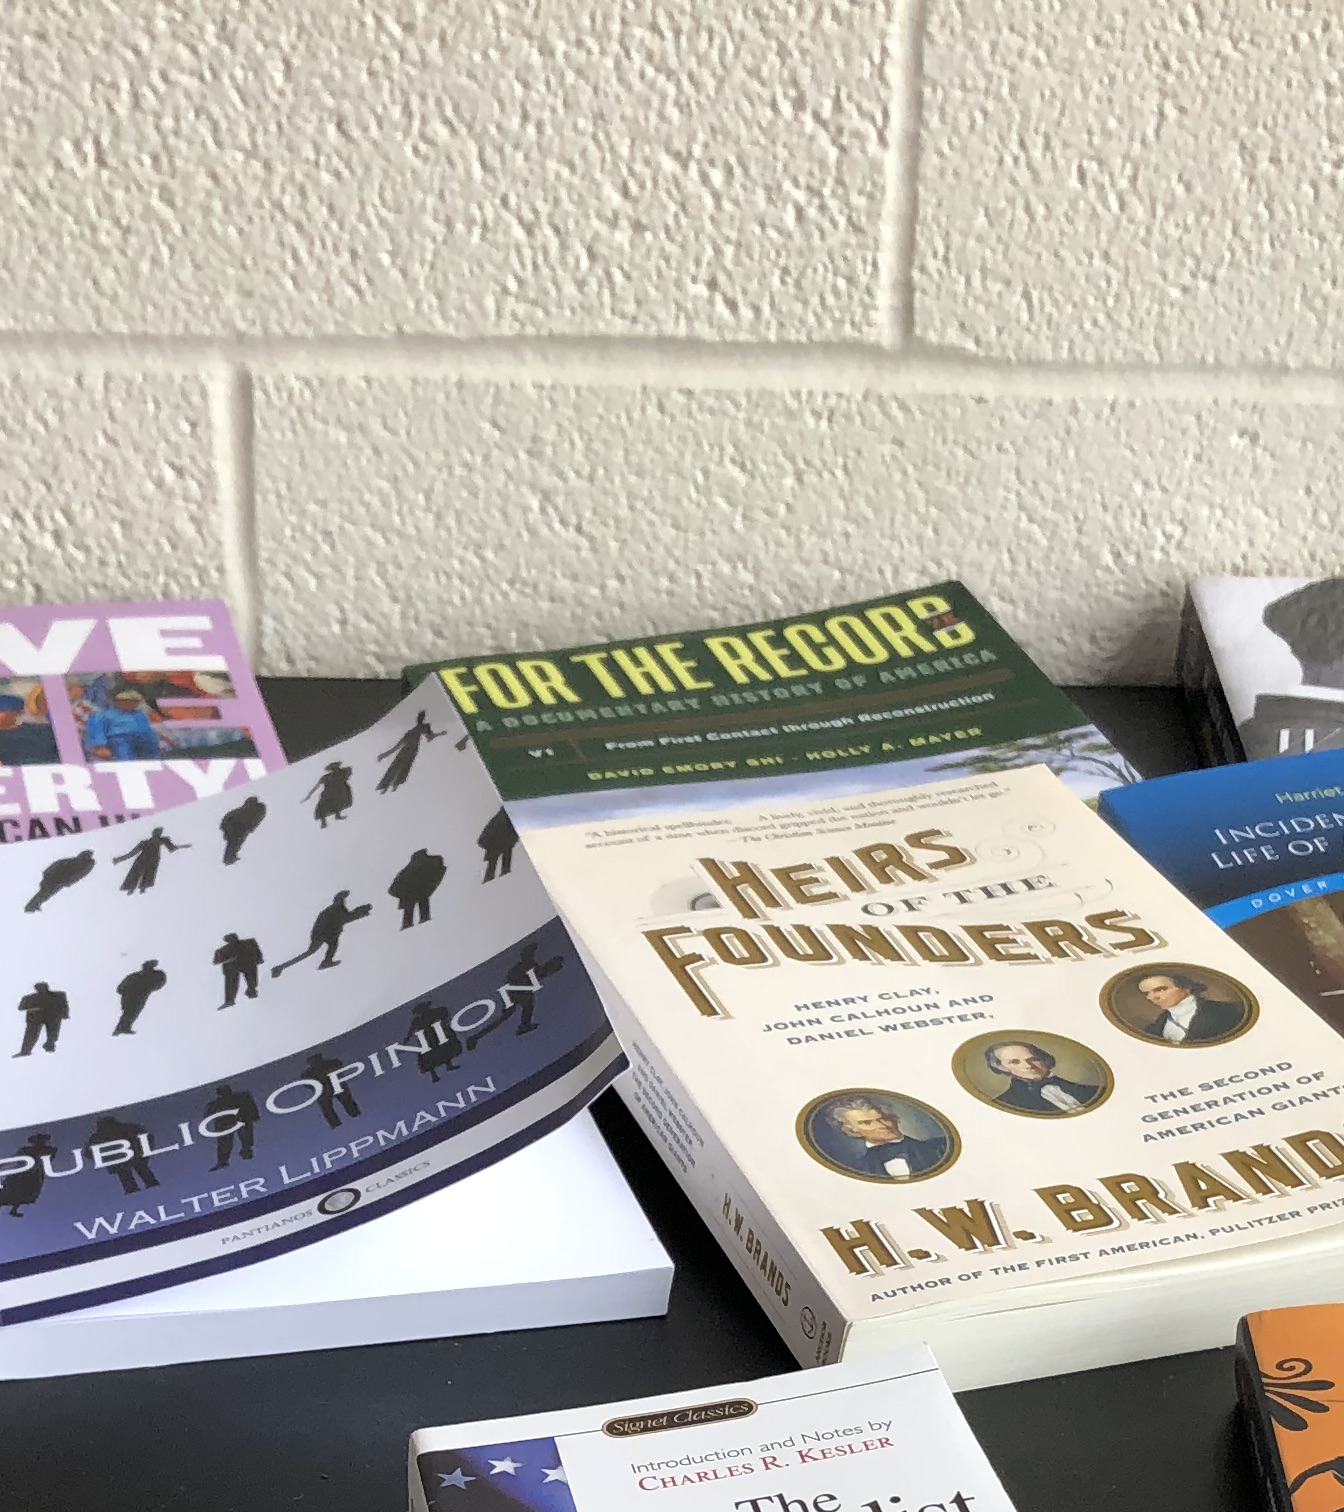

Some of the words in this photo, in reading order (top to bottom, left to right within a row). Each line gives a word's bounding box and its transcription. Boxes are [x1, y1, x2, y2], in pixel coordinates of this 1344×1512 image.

[439, 659, 582, 714] FOR
[570, 642, 714, 699] THE
[704, 595, 976, 685] RECORD
[1275, 784, 1343, 806] Harriet
[696, 823, 976, 922] HEIRS
[1210, 845, 1281, 871] LIFE
[1288, 836, 1330, 857] OF
[860, 893, 934, 919] OF
[944, 870, 1058, 906] THE
[1251, 880, 1329, 910] DOVER
[639, 907, 1169, 1021] FOUNDERS
[762, 1016, 823, 1033] JOHN
[829, 1001, 941, 1024] CALHOUN
[948, 993, 994, 1008] AND
[794, 995, 869, 1012] HENRY
[877, 986, 941, 1001] CLAY,
[263, 966, 545, 1117] OPINION
[786, 1027, 874, 1046] DANIEL
[877, 1010, 995, 1033] WEBSTER,
[1140, 1080, 1290, 1124] GENERATION
[1295, 1070, 1326, 1086] OF
[1144, 1086, 1194, 1104] THE
[1198, 1061, 1293, 1094] SECOND
[1142, 1107, 1266, 1143] AMERICAN
[73, 1176, 269, 1242] WALTER
[279, 1075, 498, 1188] LIPPMANN
[220, 1208, 315, 1247] PANTIANOS
[364, 1160, 432, 1195] CLASSICS
[870, 1276, 953, 1303] AUTHOR
[957, 1270, 984, 1283] OF
[989, 1262, 1031, 1277] THE
[1035, 1251, 1092, 1270] FIRST
[1098, 1231, 1205, 1259] AMERICAN,
[1208, 1209, 1302, 1237] PULITZER
[611, 1413, 668, 1436] Signet
[673, 1401, 750, 1426] Classics
[630, 1443, 753, 1475] Introduction
[759, 1436, 795, 1454] and
[801, 1422, 864, 1445] Notes
[868, 1418, 893, 1433] by
[637, 1461, 755, 1492] CHARLES
[761, 1454, 791, 1471] R.
[797, 1436, 895, 1465] KESLER
